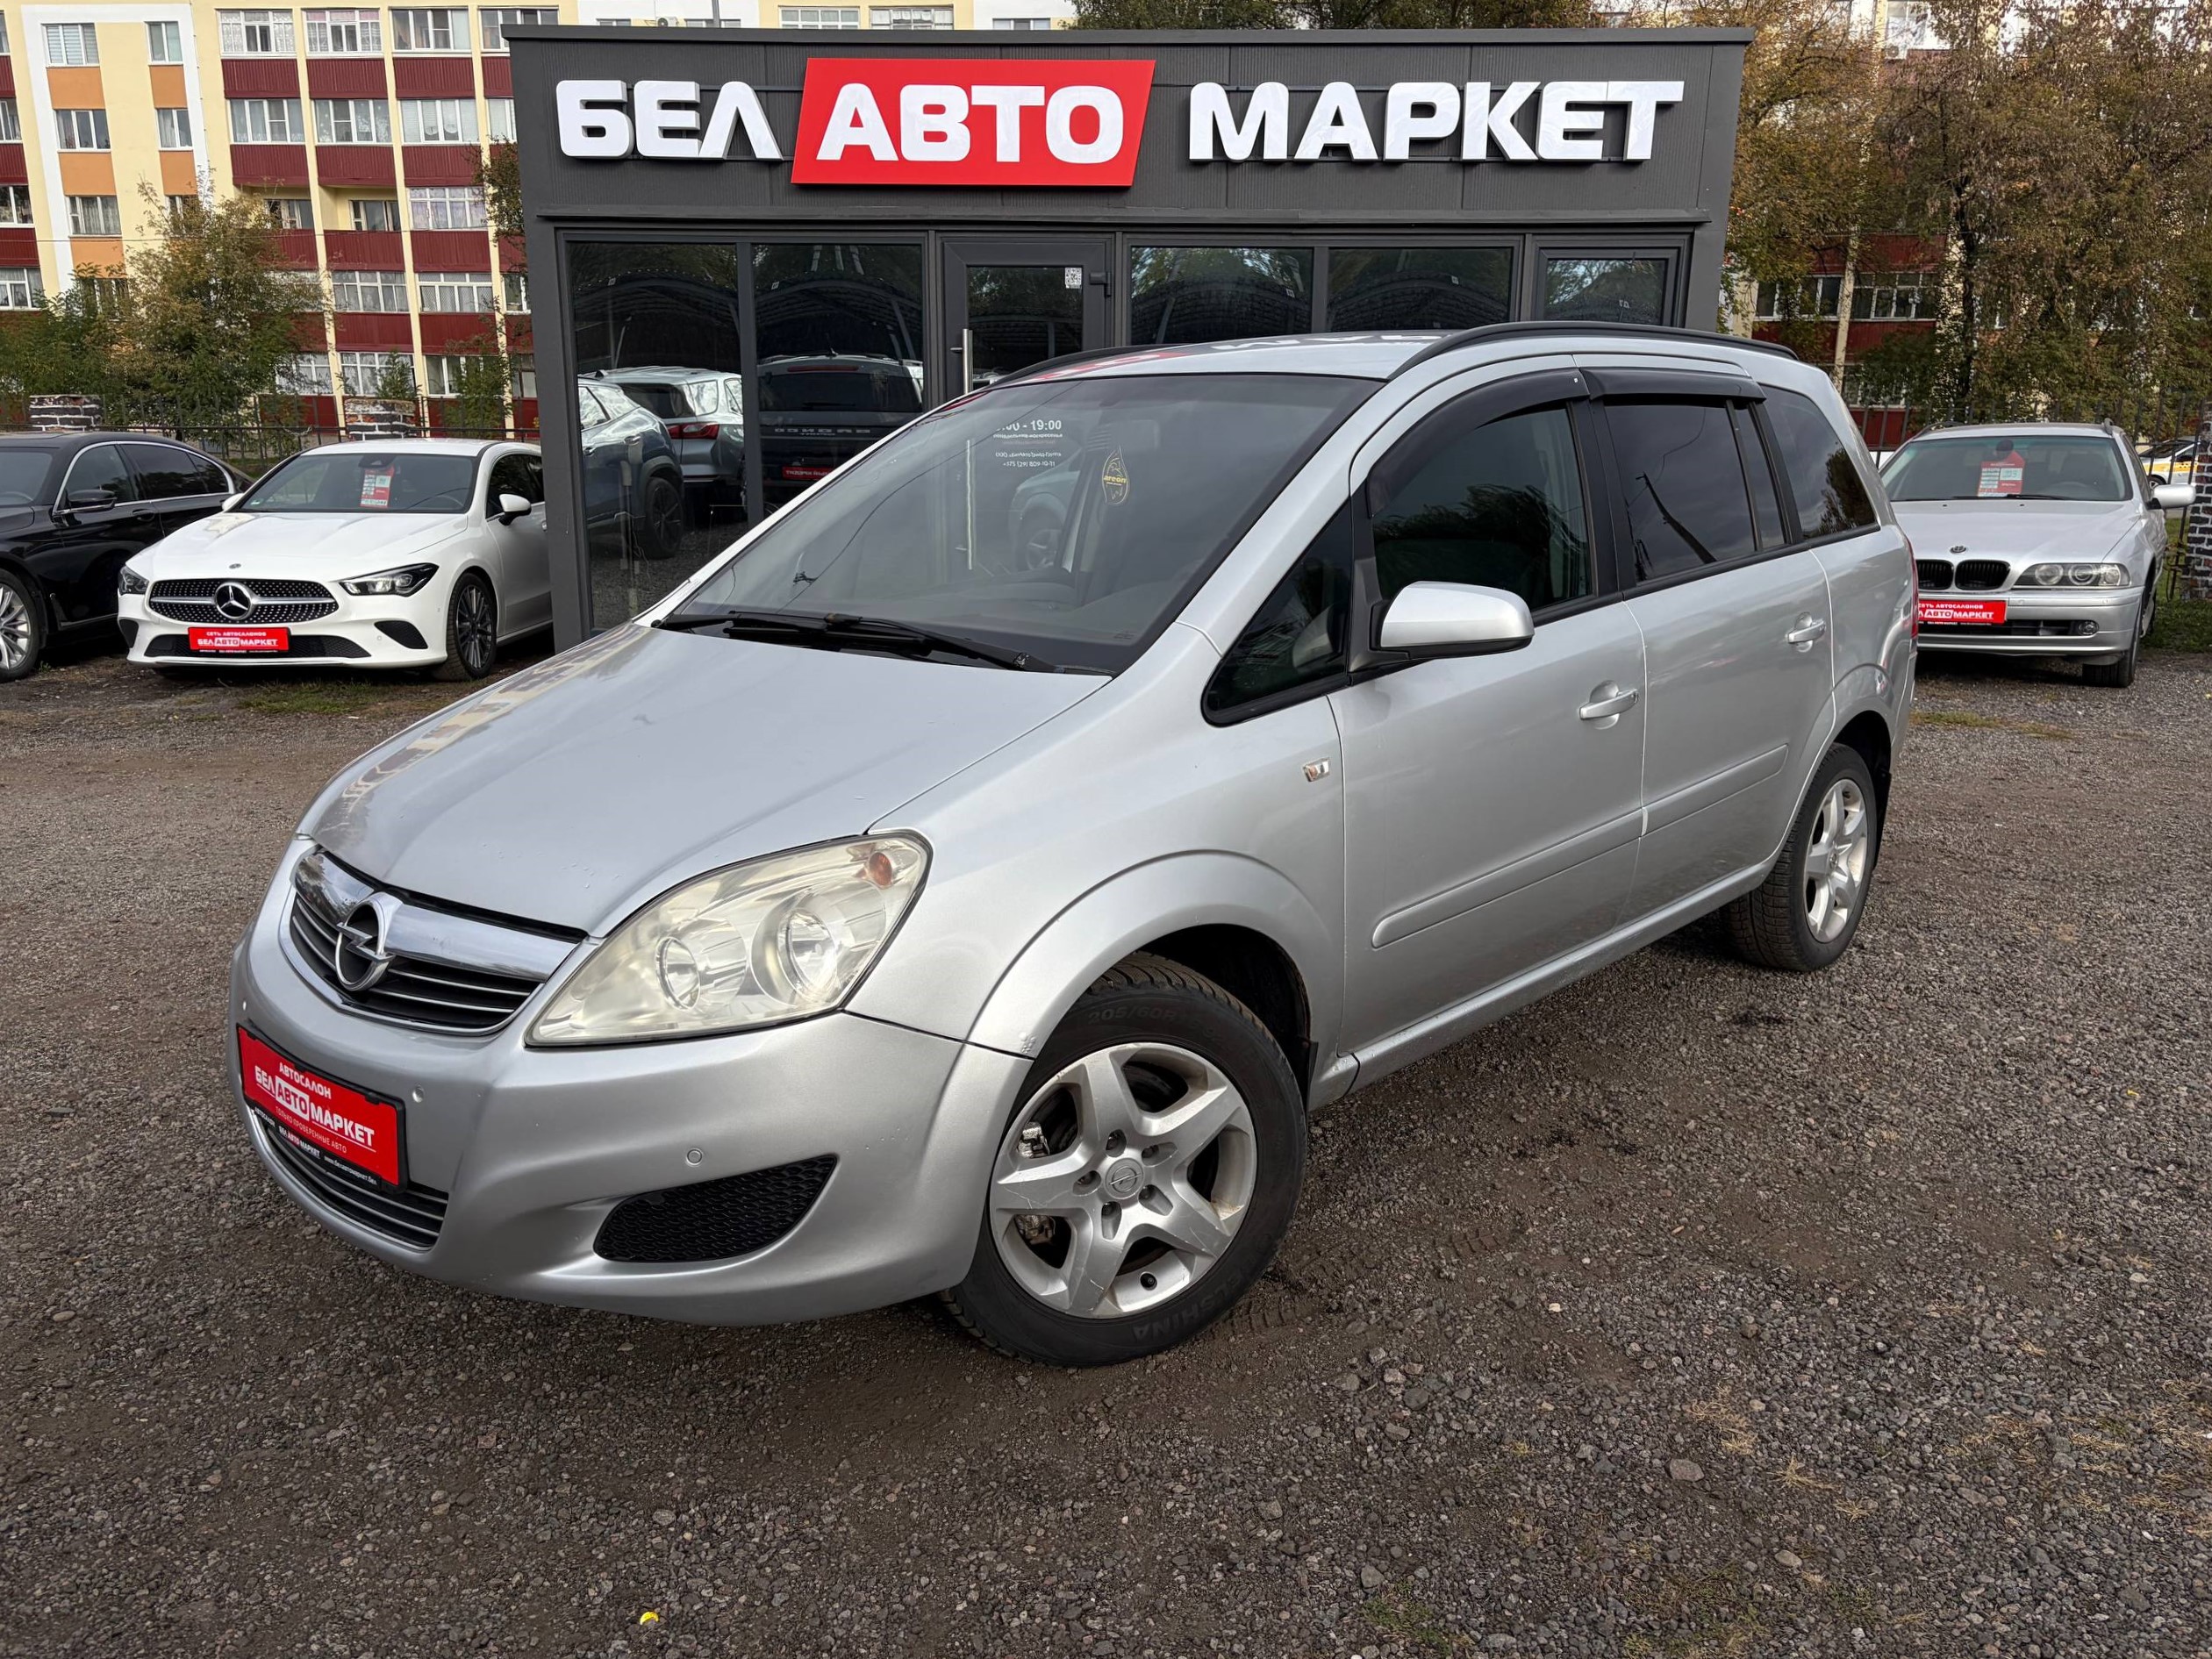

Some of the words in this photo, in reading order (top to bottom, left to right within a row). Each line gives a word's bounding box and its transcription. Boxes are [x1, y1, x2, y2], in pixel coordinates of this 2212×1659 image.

[555, 80, 784, 159] БЕЛ
[816, 82, 1124, 164] АВТО
[1188, 81, 1685, 161] МАРКЕТ
[1030, 419, 1062, 431] 19:00
[279, 1062, 332, 1100] АВТОСАЛОН
[254, 1064, 276, 1096] БЕЛ
[277, 1087, 308, 1115] АВТО
[310, 1102, 375, 1147] МАРКЕТ
[276, 1106, 293, 1124] ТОЛЬКО
[292, 1119, 331, 1146] ПРОВЕРЕННЫЕ
[331, 1141, 347, 1154] АВТО
